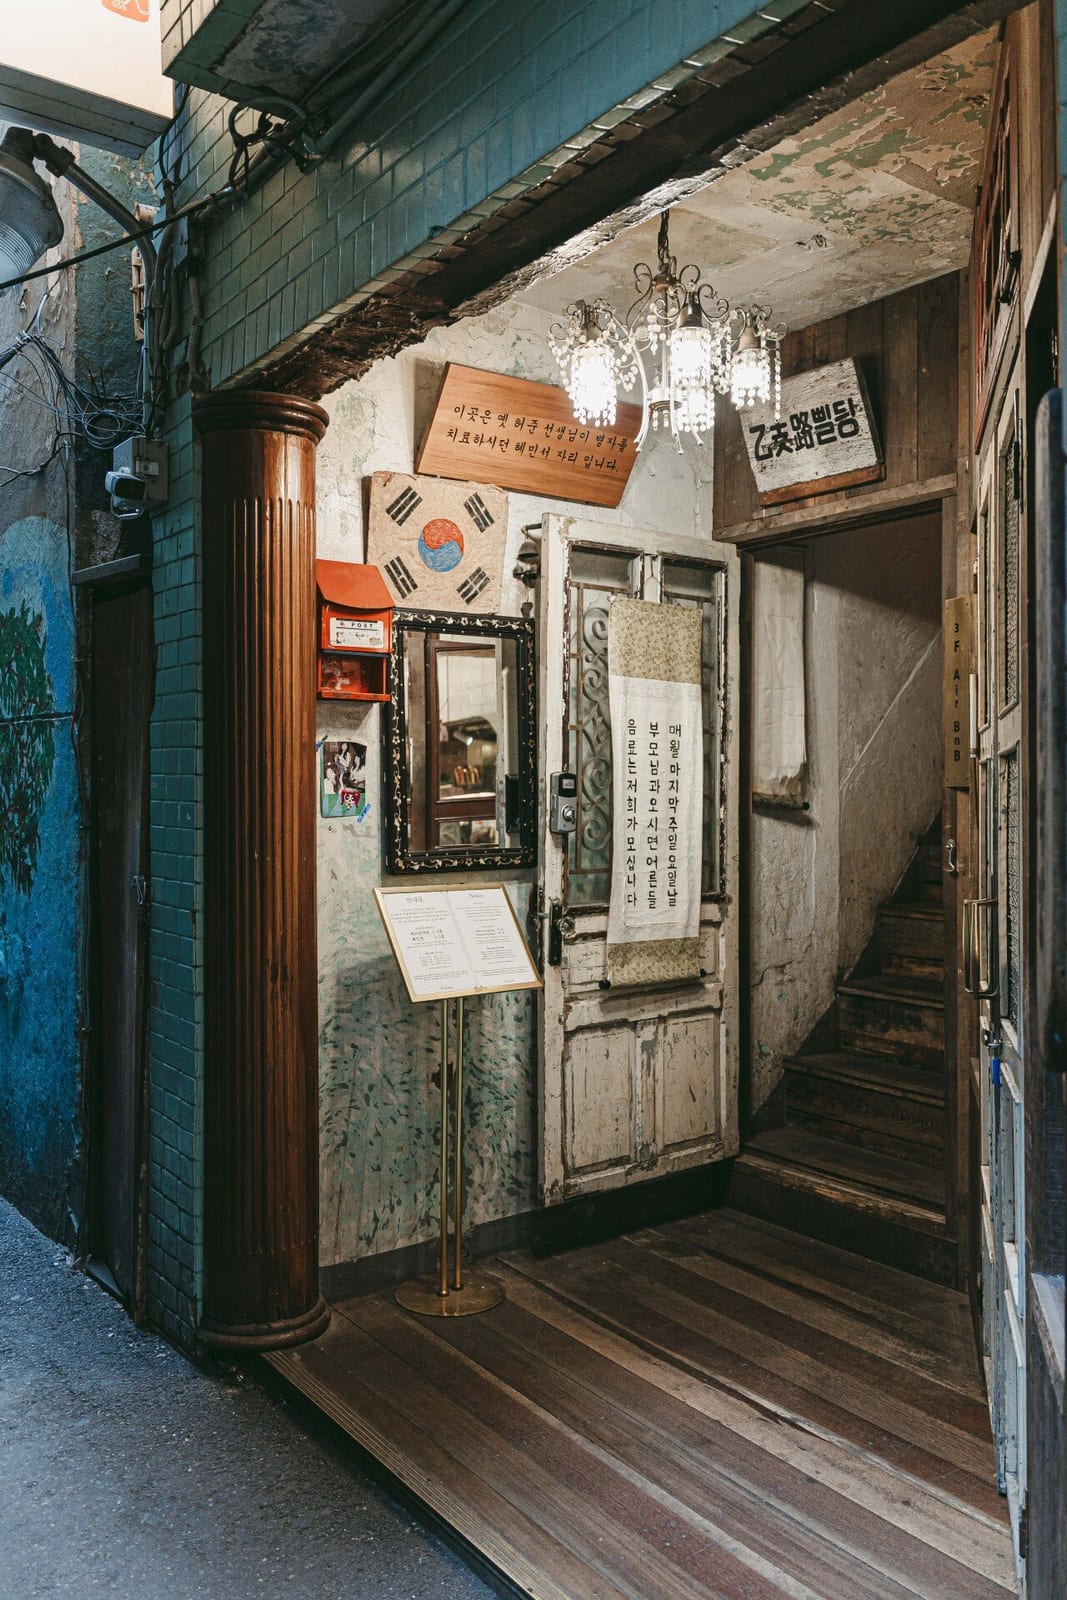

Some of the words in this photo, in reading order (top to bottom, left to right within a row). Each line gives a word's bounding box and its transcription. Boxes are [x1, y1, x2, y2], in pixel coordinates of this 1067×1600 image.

[445, 427, 510, 453] 치료하시던
[514, 441, 551, 460] 혜민서
[556, 449, 579, 465] 자리
[583, 454, 619, 473] 입니다.
[453, 403, 492, 425] 이곳은
[497, 412, 509, 429] 옛
[513, 416, 539, 435] 허준
[543, 423, 590, 444] 선생님이
[595, 434, 629, 453] 병자를
